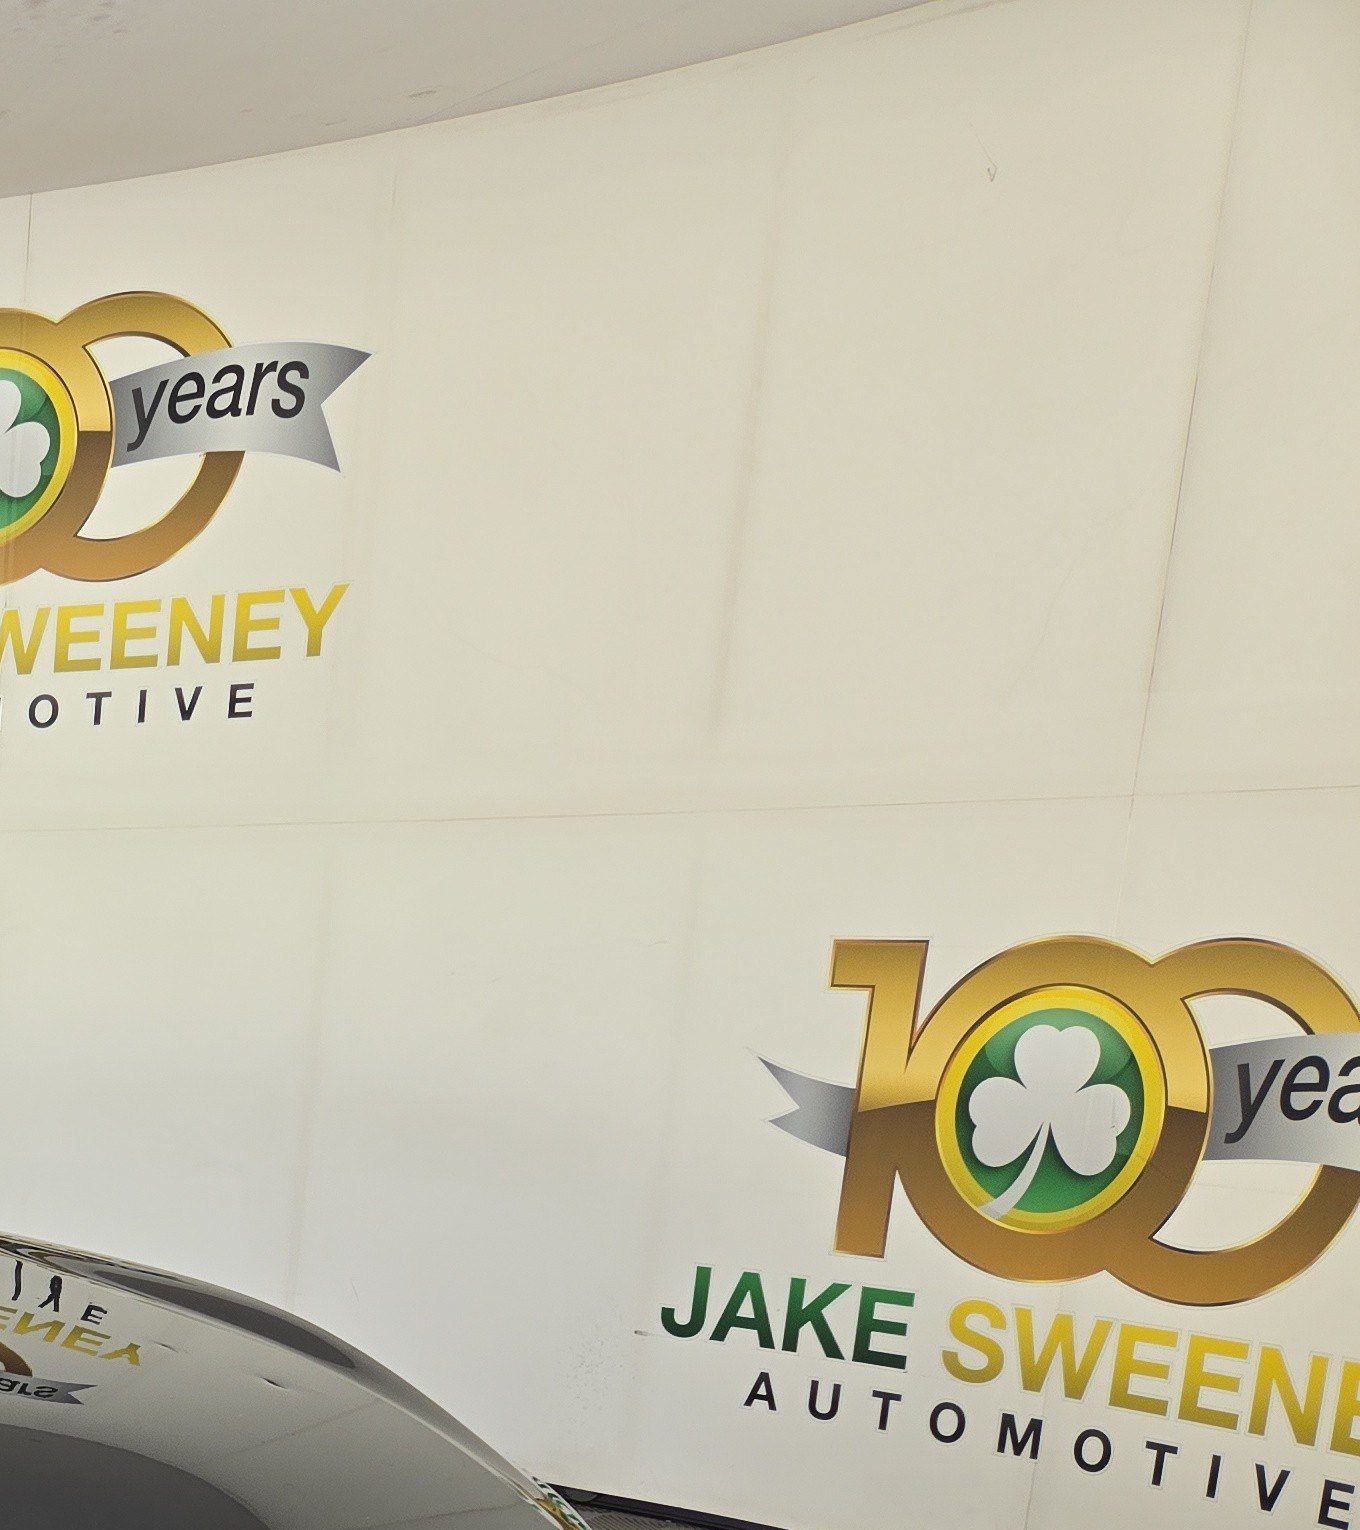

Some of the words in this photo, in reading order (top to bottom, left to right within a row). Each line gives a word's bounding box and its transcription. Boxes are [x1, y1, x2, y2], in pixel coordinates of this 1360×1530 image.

[127, 359, 310, 452] years
[829, 935, 1360, 1307] 100
[1223, 1055, 1360, 1144] yea
[660, 1265, 916, 1371] JAKE
[742, 1370, 1356, 1530] AUTOMOTIVE
